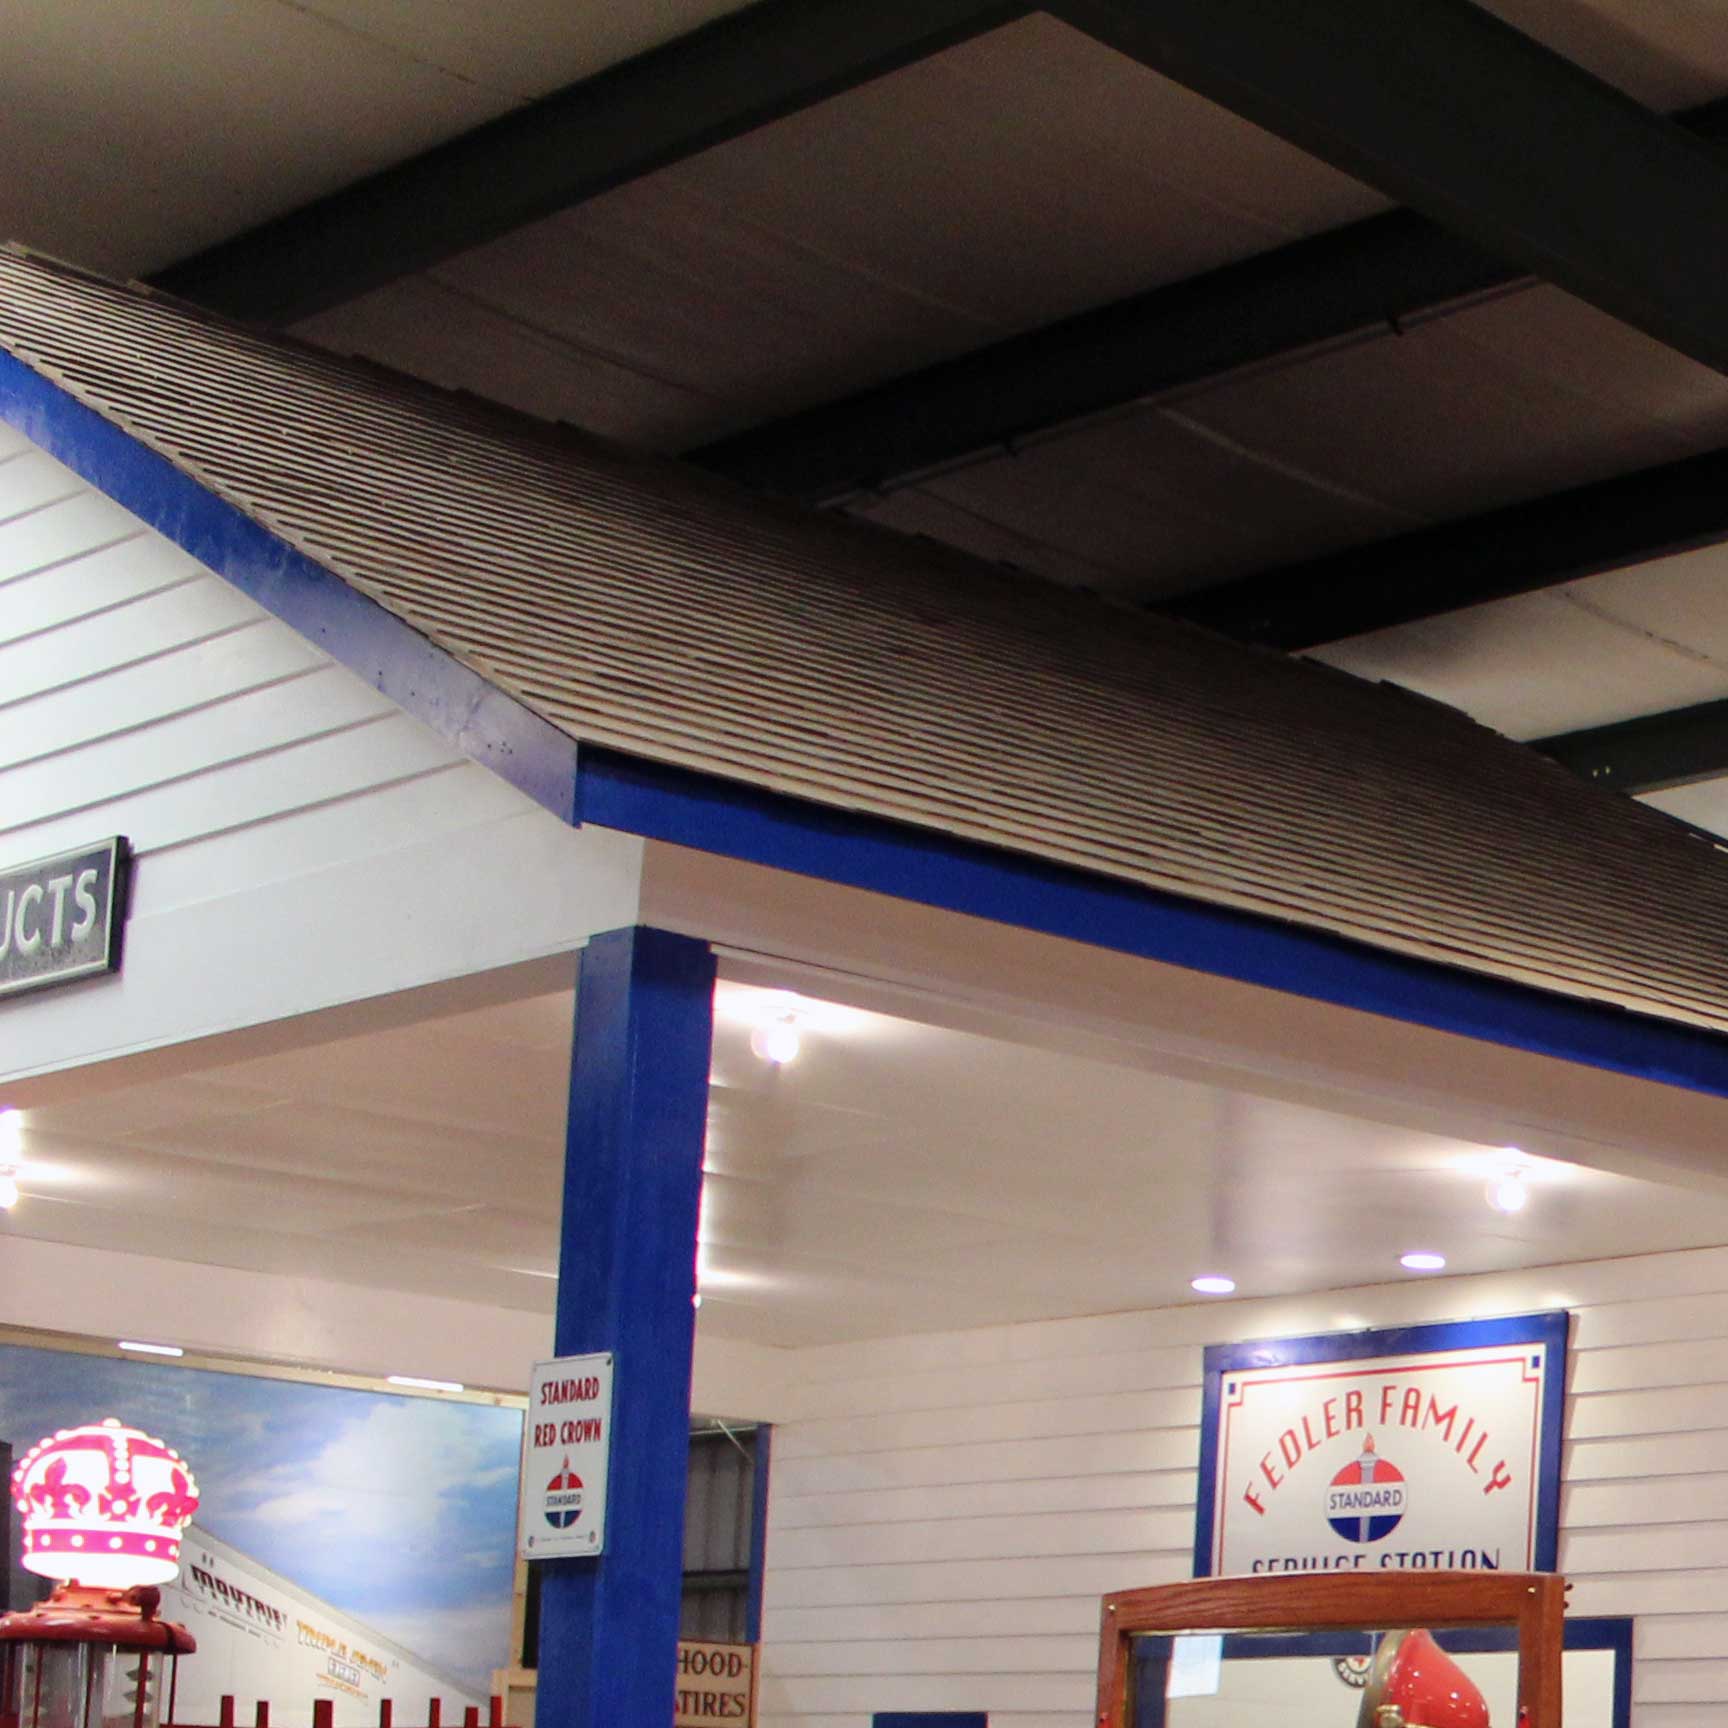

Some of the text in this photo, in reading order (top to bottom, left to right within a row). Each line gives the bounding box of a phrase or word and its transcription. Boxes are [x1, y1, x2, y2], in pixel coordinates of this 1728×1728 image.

[540, 1376, 600, 1405] STANDARD
[534, 1417, 602, 1448] RED CROWN
[1243, 1384, 1512, 1516] FEDLER FAMILY
[546, 1493, 582, 1507] STANDARD
[1329, 1488, 1403, 1511] STANDARD
[679, 1691, 746, 1717] TIRES
